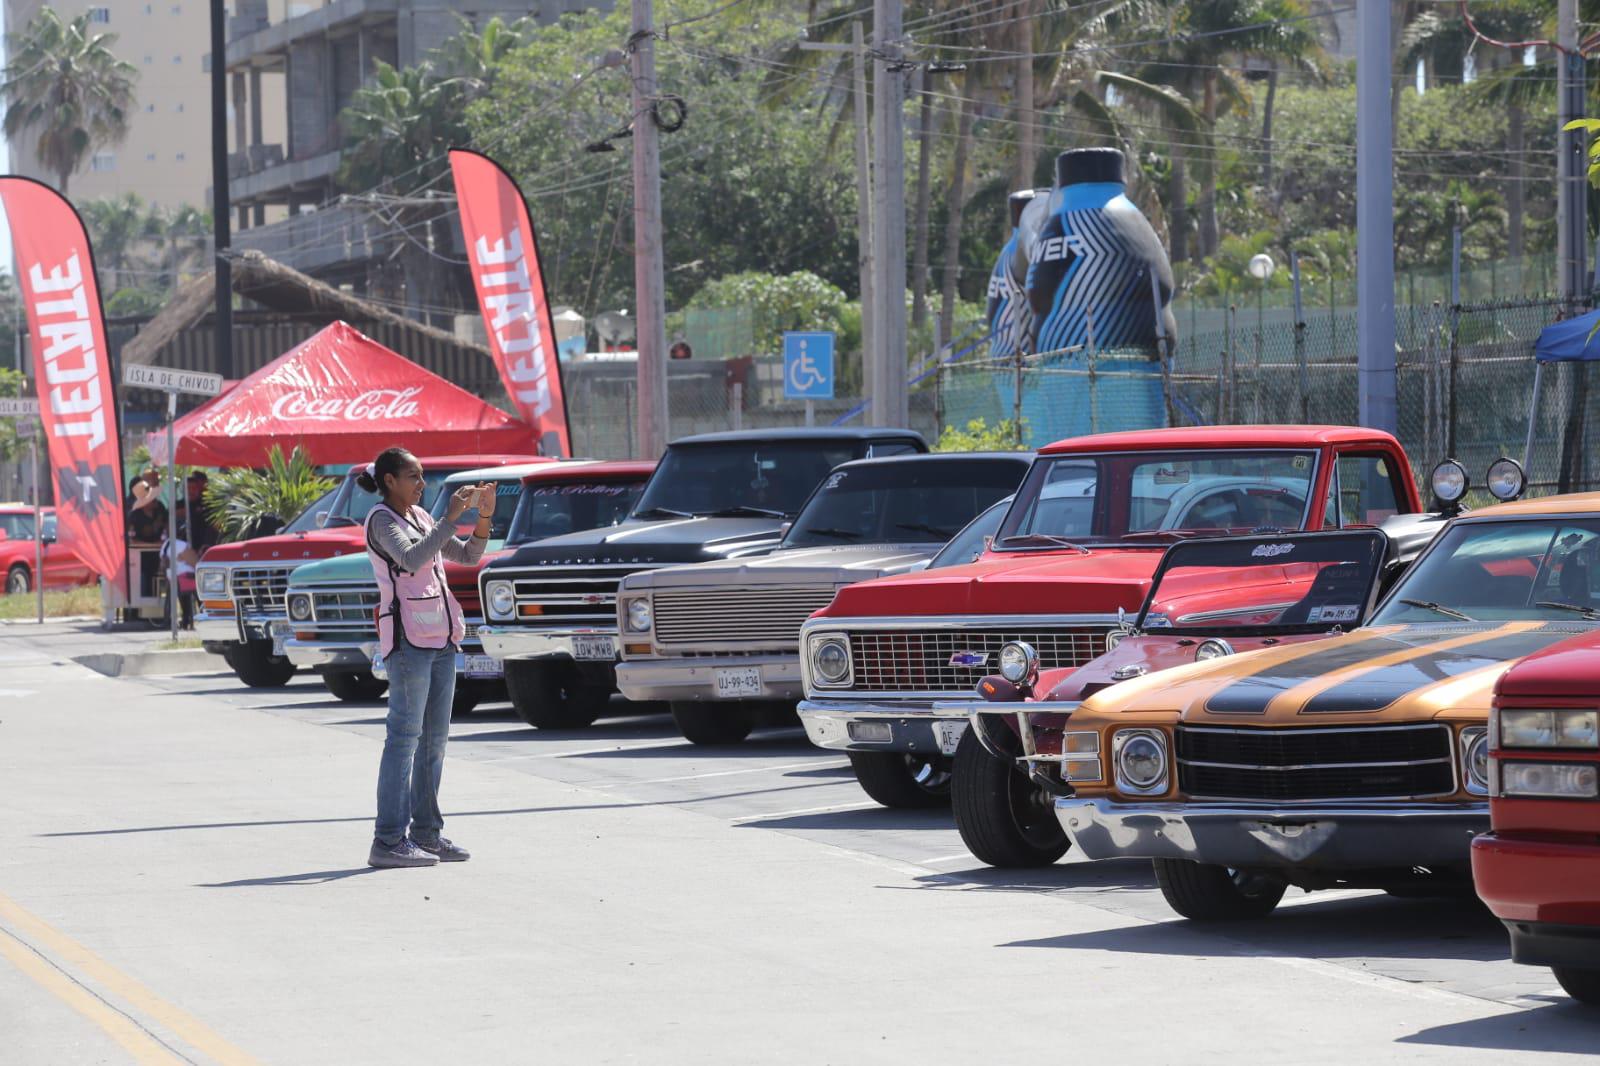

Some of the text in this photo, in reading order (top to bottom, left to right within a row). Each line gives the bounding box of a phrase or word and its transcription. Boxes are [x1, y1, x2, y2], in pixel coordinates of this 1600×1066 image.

[130, 368, 216, 392] ISLA DE CHIVOS
